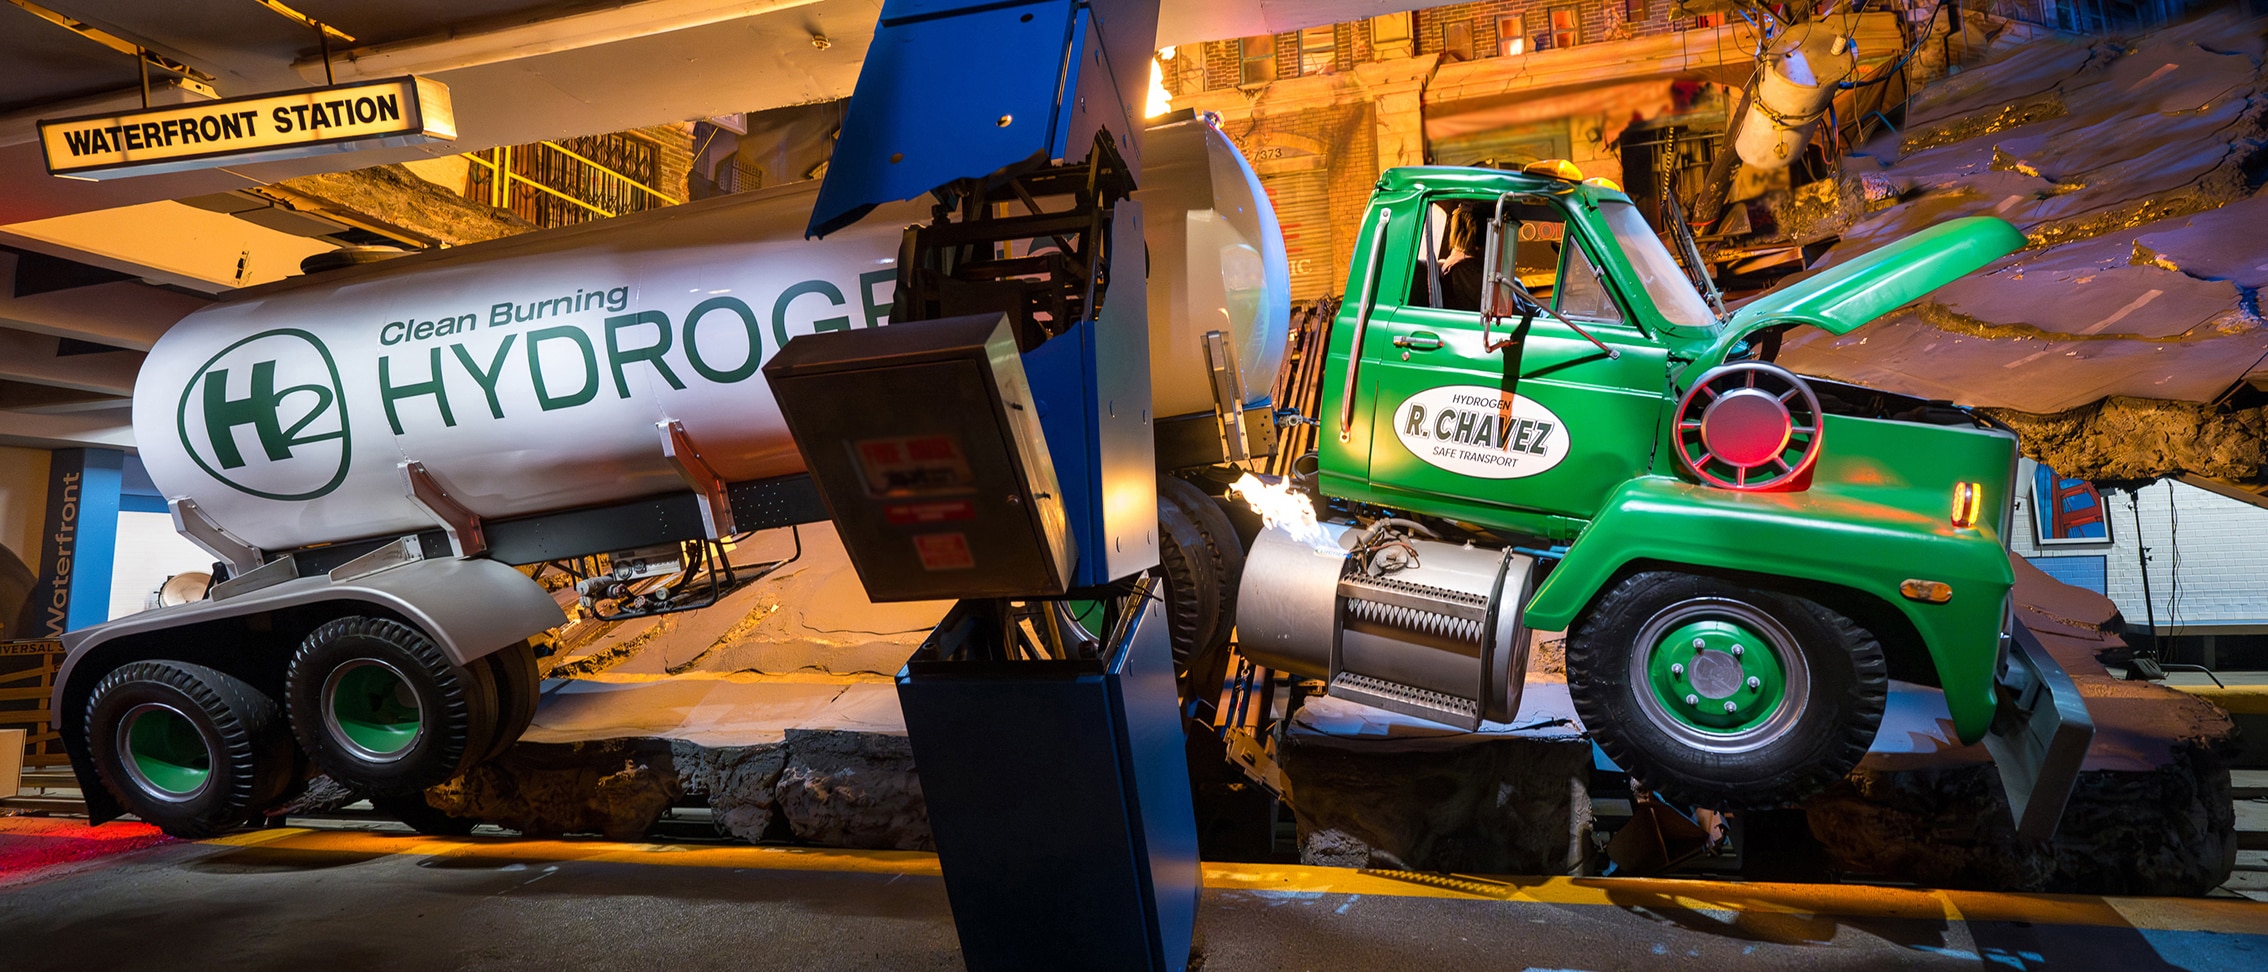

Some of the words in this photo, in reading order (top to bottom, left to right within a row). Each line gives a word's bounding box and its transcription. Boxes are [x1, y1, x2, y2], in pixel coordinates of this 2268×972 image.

[64, 111, 258, 157] WATERFRONT
[274, 93, 400, 134] STATION
[1254, 148, 1282, 161] 7373
[380, 311, 477, 346] Clean
[489, 285, 629, 328] Burning
[203, 360, 343, 470] H2
[1404, 402, 1430, 438] R.
[1435, 407, 1554, 456] CHAVEZ
[1452, 394, 1513, 411] HYDROGEN
[1432, 446, 1455, 458] SAFE
[1459, 450, 1518, 468] TRANSPORT
[45, 472, 80, 638] Waterfront
